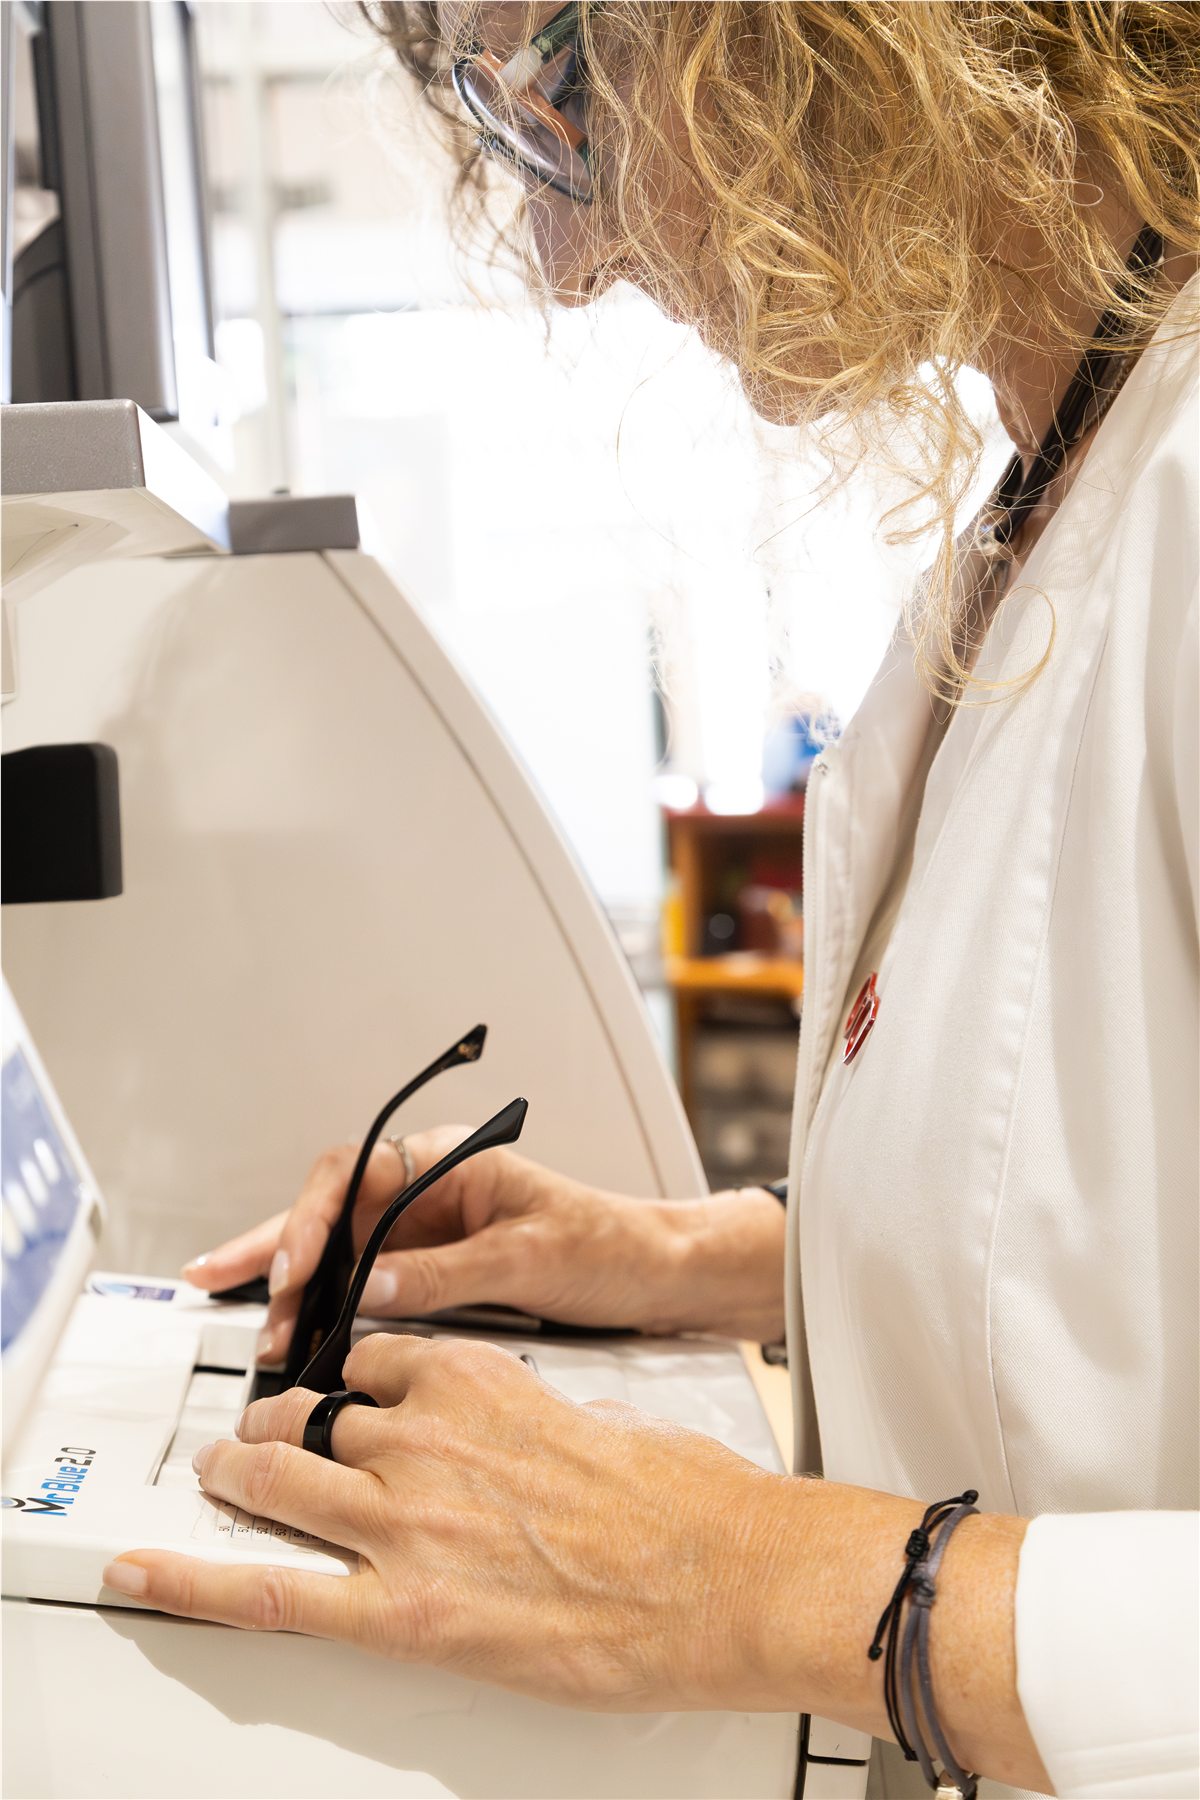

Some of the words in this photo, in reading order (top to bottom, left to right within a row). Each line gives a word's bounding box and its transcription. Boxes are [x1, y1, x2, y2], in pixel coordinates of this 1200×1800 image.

[54, 1447, 97, 1466] 2.0
[41, 1466, 88, 1493] Blue
[20, 1493, 75, 1516] Mr
[275, 1527, 287, 1536] 53
